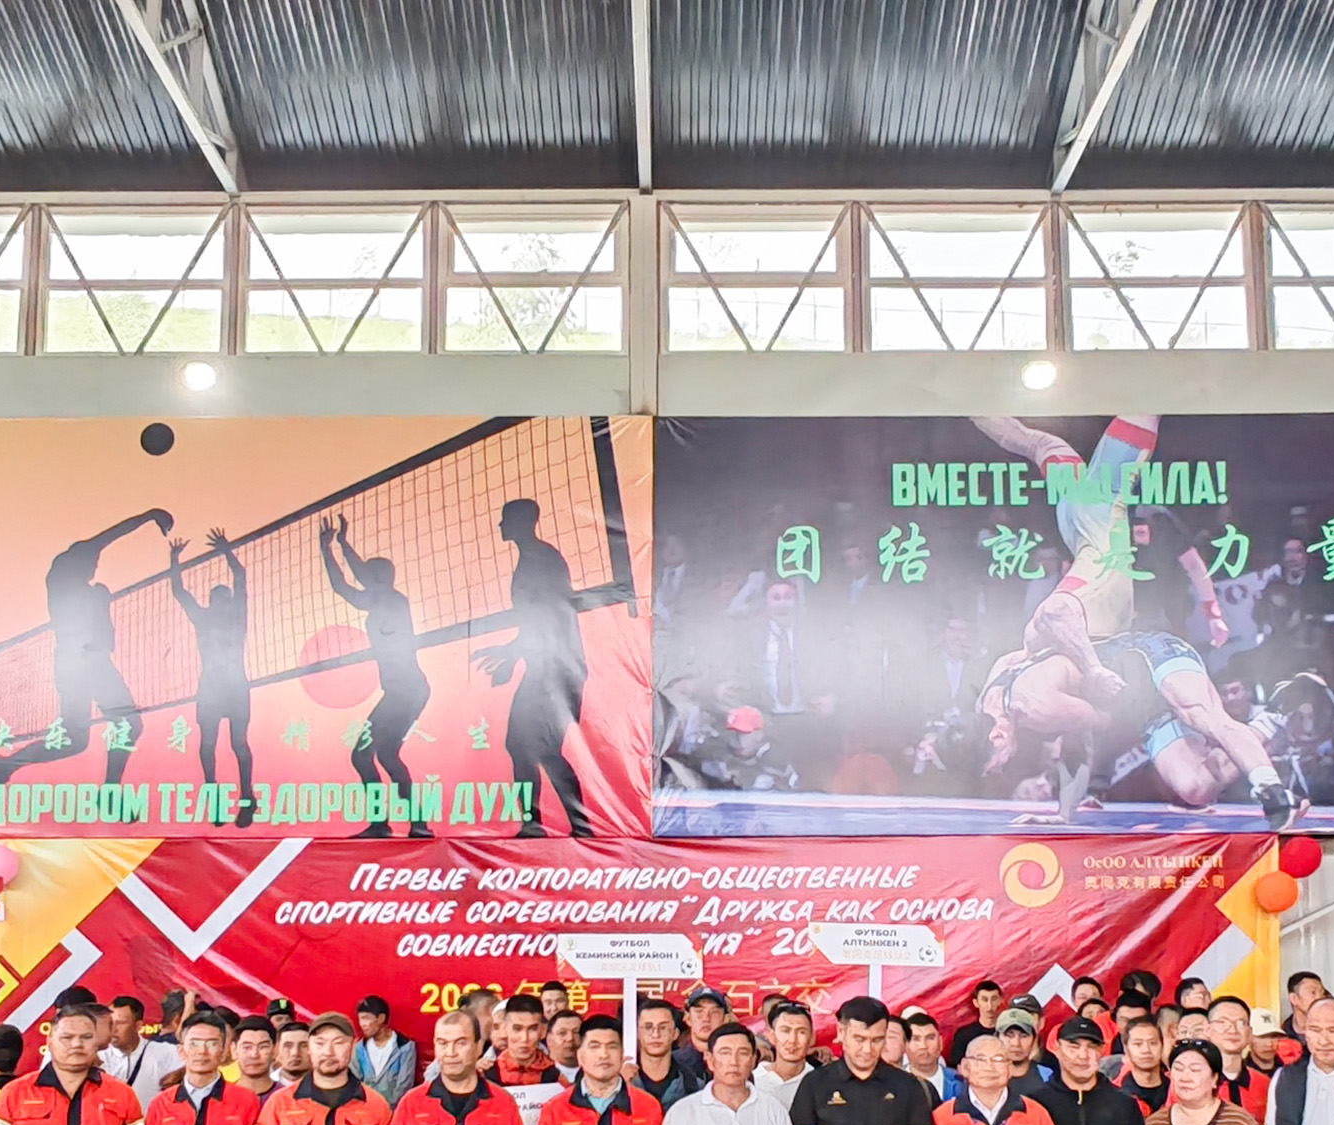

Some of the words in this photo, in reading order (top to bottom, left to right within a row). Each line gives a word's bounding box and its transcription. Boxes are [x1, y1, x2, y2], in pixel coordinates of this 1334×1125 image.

[1119, 460, 1229, 506] СИЛА!
[449, 781, 534, 825] ДУХ!
[275, 899, 458, 926] СПОРТИВНЫЕ
[465, 898, 680, 925] СОРЕВНОВАНИЯ
[825, 898, 886, 922] КАК
[888, 897, 995, 922] ОСНОВА
[396, 932, 559, 959] СОВМЕСТНО
[842, 939, 900, 947] АЛТЫНКЕН
[854, 929, 897, 937] ФУТБОЛ
[575, 951, 636, 959] КЕМИНСКИЙ
[639, 950, 673, 959] РАЙОН
